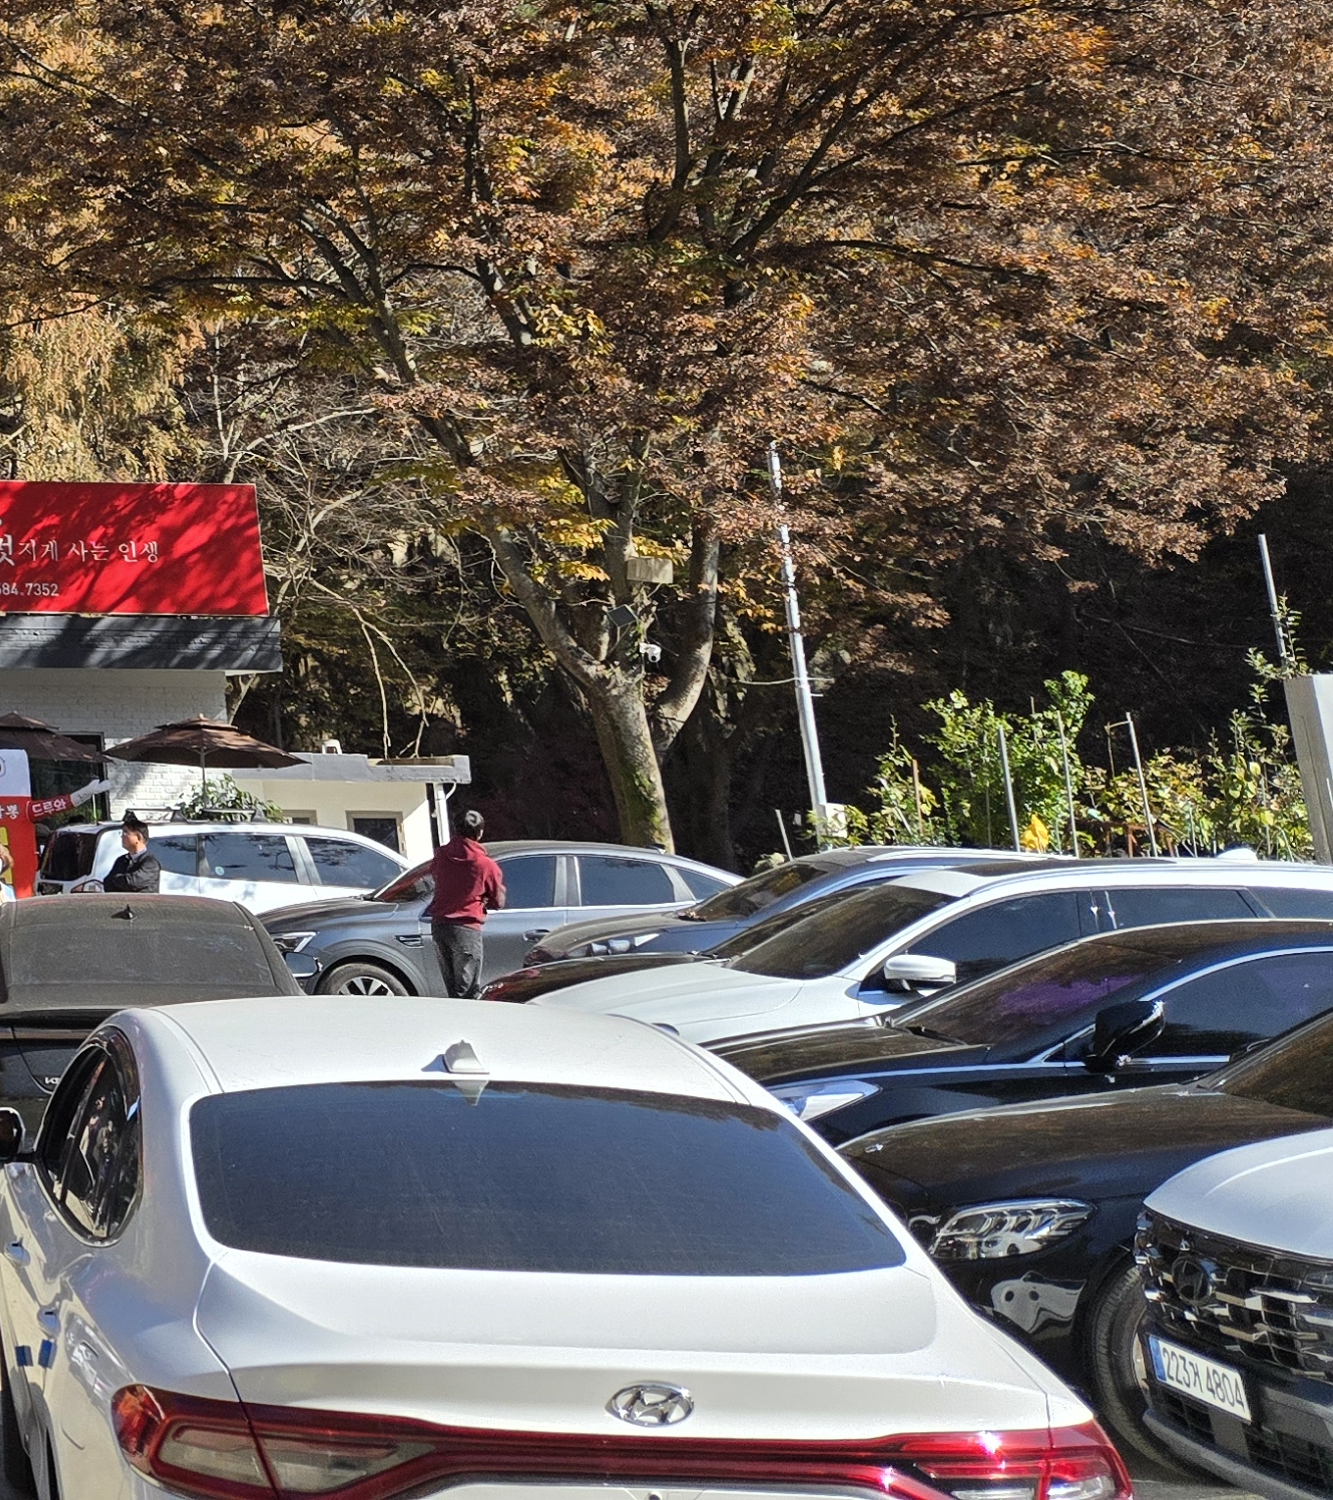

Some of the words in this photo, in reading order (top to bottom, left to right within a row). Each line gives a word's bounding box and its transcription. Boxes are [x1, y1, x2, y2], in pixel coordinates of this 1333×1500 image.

[68, 540, 110, 561] 사는
[119, 541, 158, 563] 인생
[32, 799, 67, 817] 드루와
